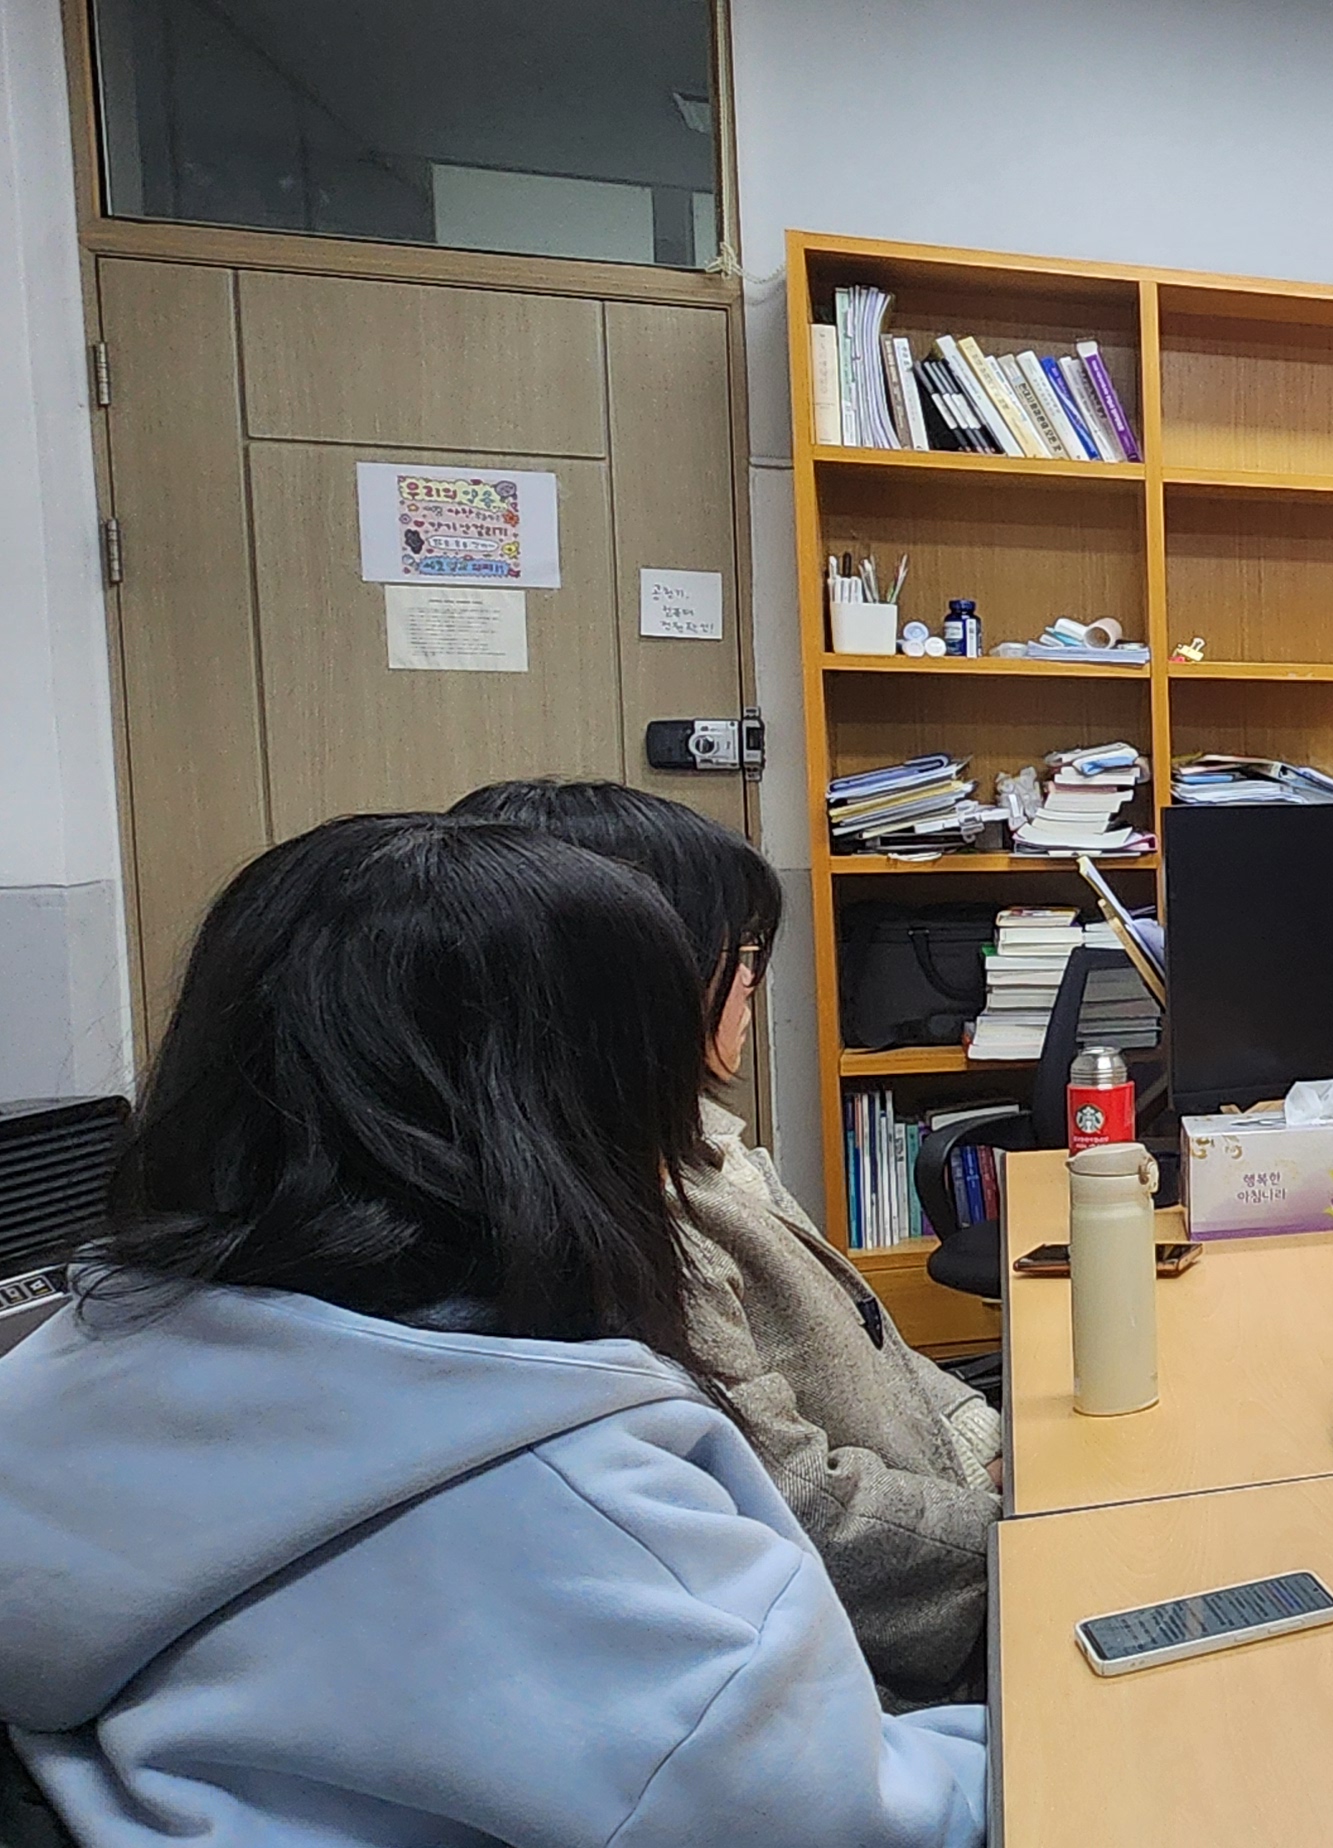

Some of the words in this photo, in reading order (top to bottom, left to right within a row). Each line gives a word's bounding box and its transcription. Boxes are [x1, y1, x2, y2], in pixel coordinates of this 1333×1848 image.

[407, 481, 457, 501] 우리의
[1243, 1172, 1281, 1188] 행복한
[1237, 1187, 1286, 1204] 아침나라
